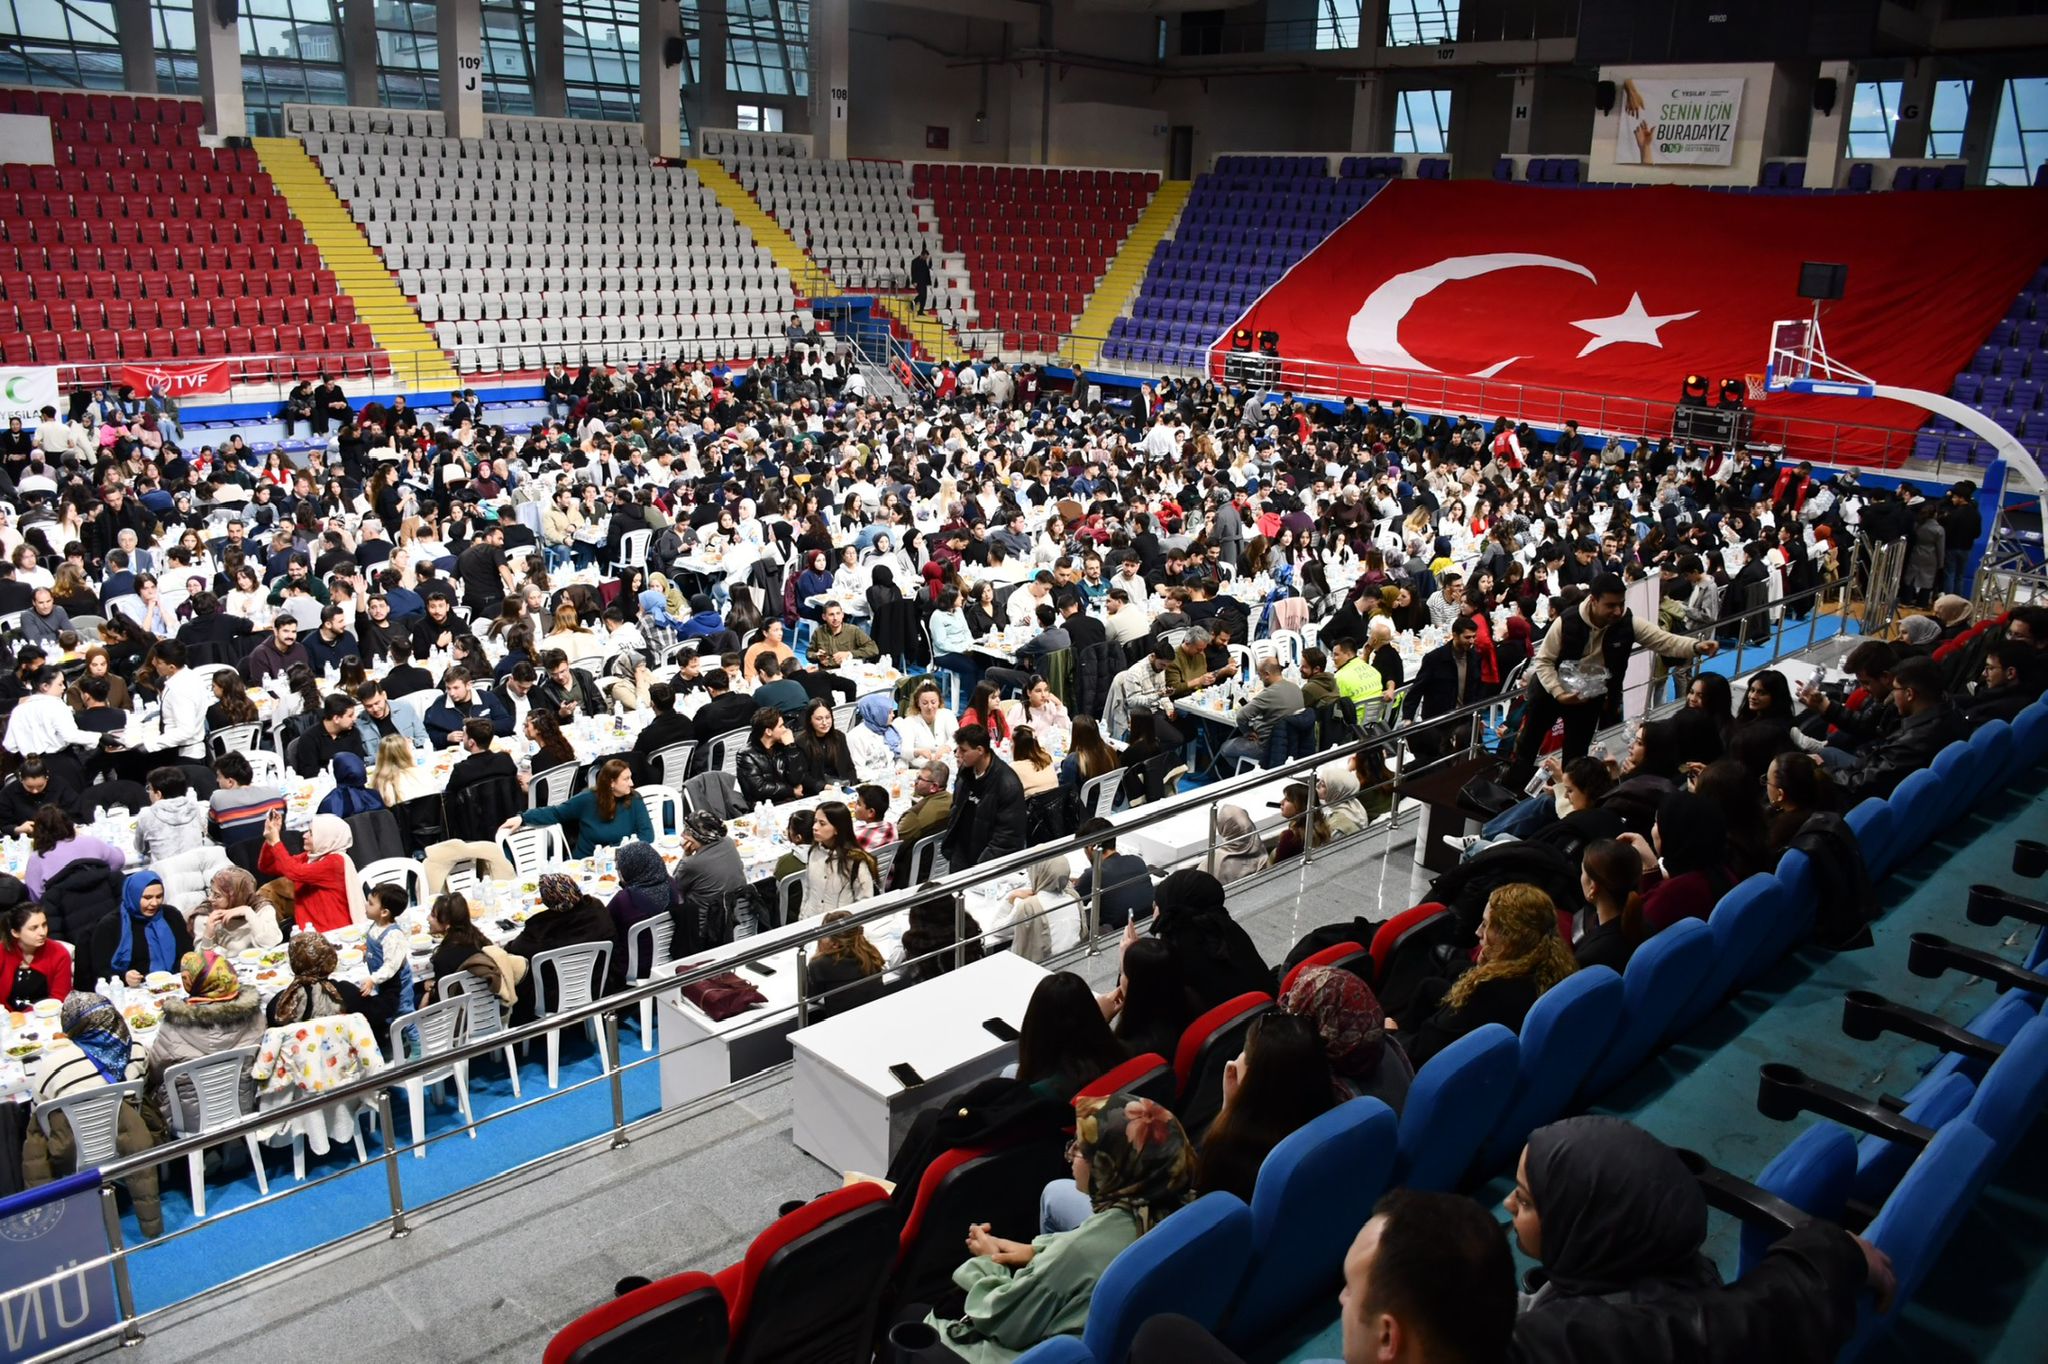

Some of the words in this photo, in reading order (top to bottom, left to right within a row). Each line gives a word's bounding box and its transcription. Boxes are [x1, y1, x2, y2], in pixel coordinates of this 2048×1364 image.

[1437, 49, 1455, 60] 107
[459, 56, 480, 70] 109
[465, 76, 476, 91] J
[831, 88, 848, 100] 108
[1516, 106, 1527, 119] H
[1660, 101, 1702, 120] SENİN
[1704, 101, 1732, 122] İÇİN
[1904, 105, 1918, 119] G
[1656, 123, 1730, 142] BURADAYIZ
[175, 373, 209, 389] TVF
